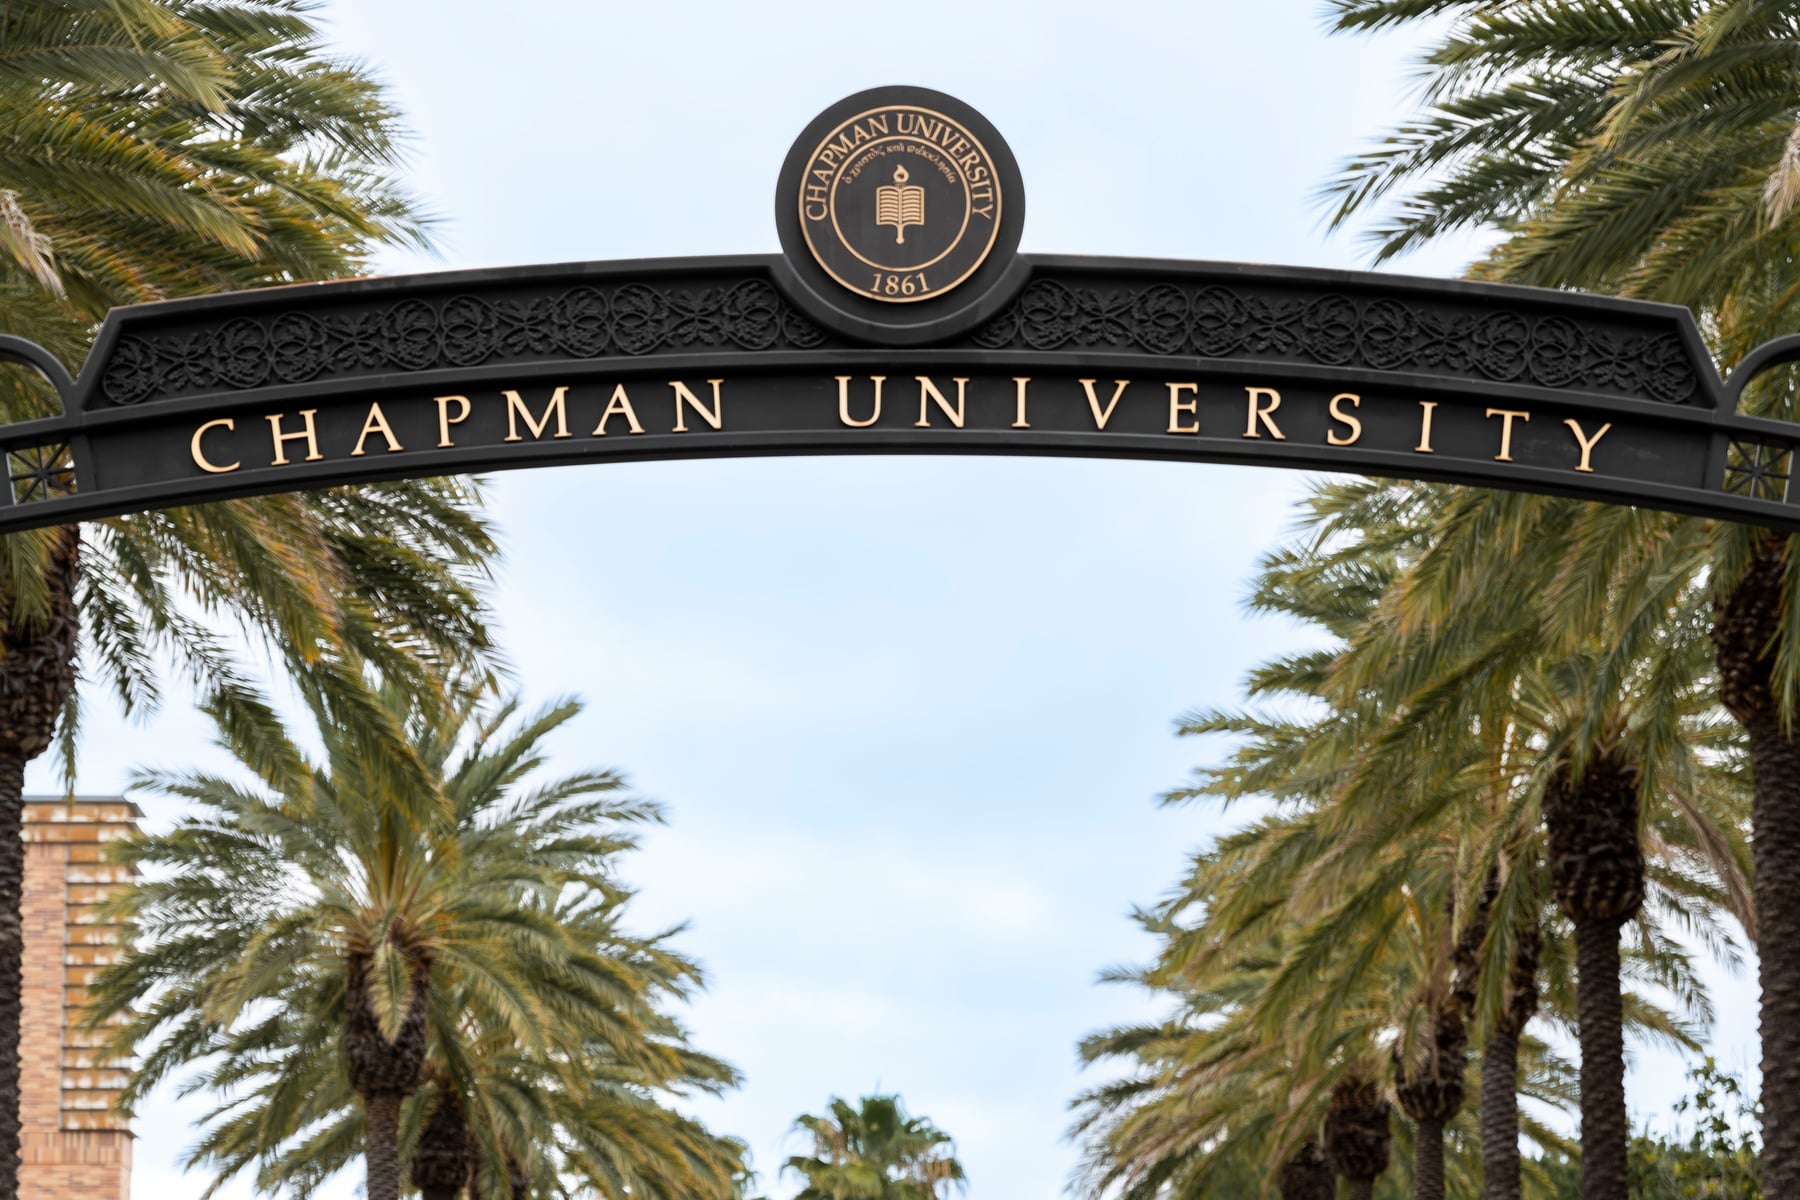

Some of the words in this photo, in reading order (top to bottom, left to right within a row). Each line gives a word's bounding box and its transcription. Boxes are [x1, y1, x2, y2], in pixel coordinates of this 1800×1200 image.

[805, 113, 890, 221] CHAPMAN
[896, 112, 994, 220] UNIVERSITY
[870, 272, 931, 296] 1861
[190, 379, 724, 474] CHAPMAN
[834, 374, 1612, 472] UNIVERSITY
